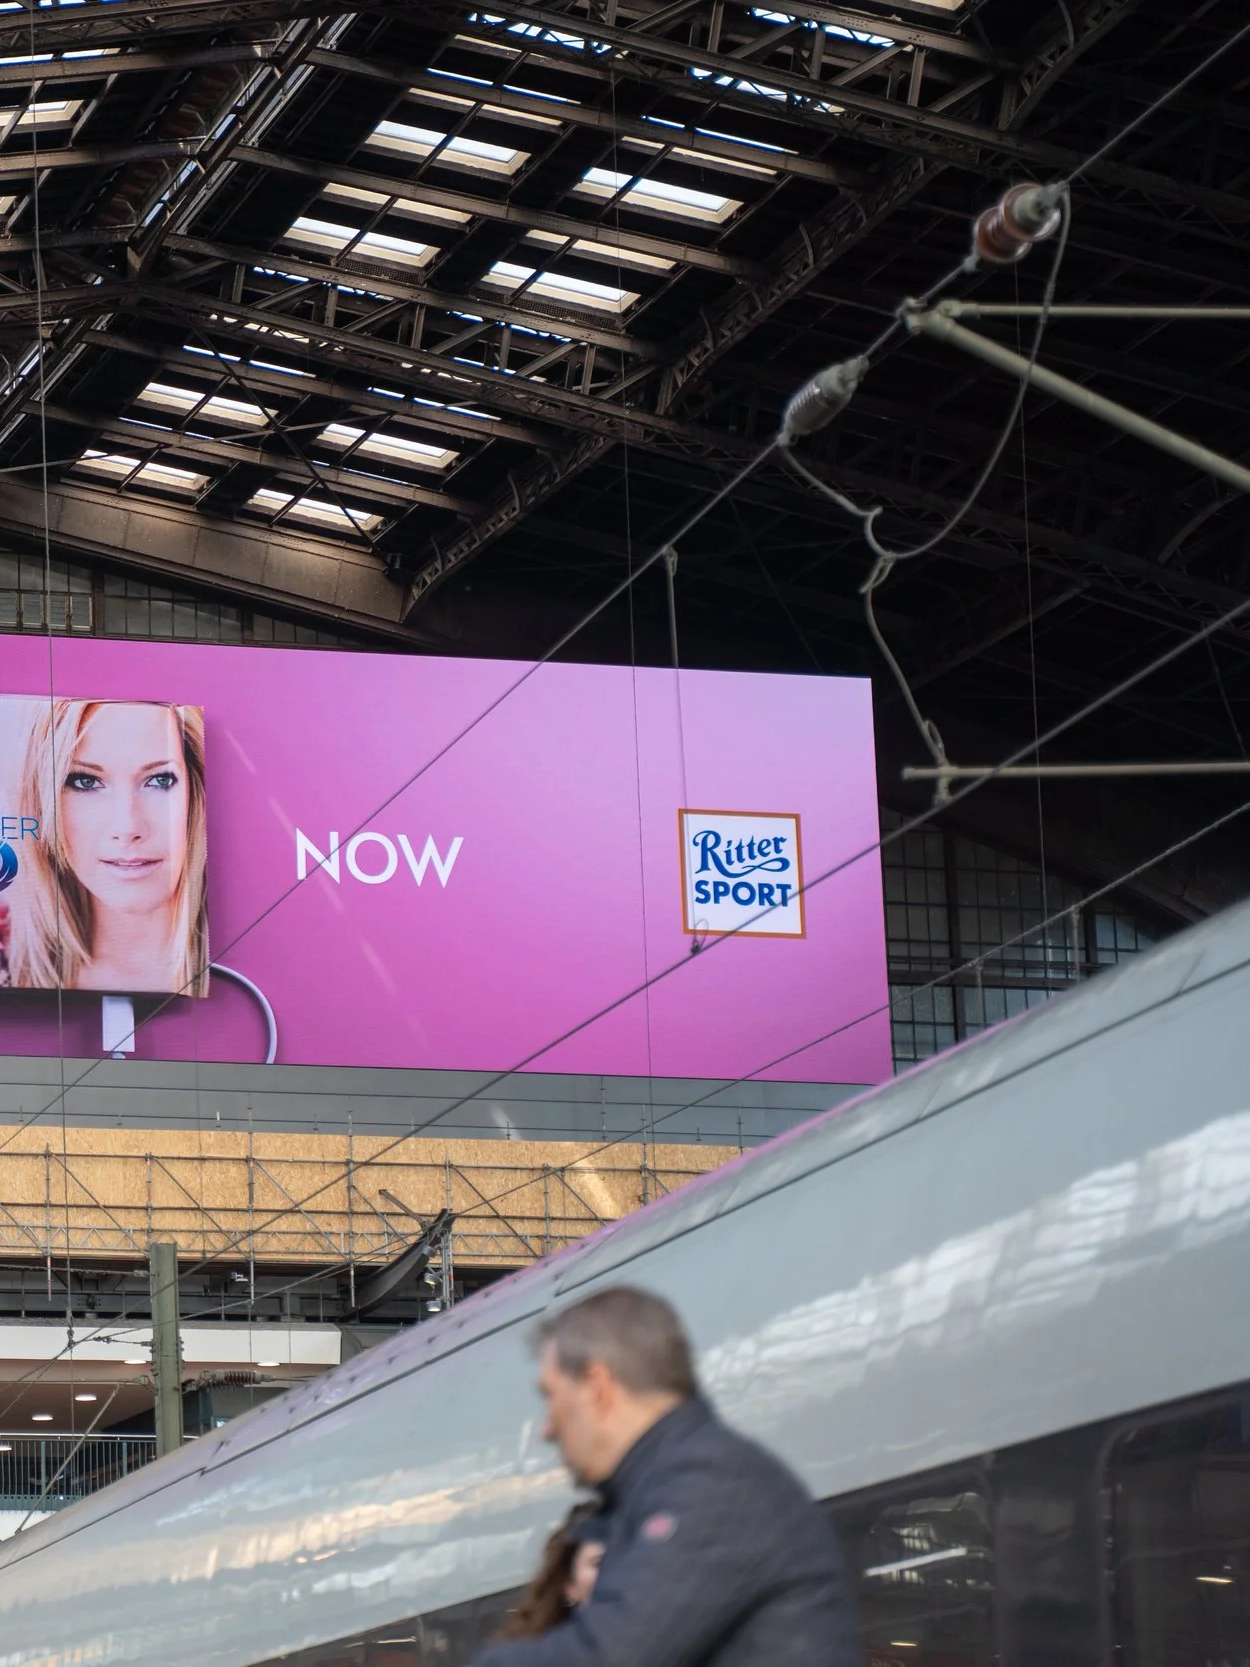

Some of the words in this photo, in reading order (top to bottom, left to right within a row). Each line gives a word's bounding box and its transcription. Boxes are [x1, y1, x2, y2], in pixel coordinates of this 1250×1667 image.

[296, 827, 464, 888] NOW
[692, 830, 790, 878] Ritter
[694, 879, 792, 907] SPORT
